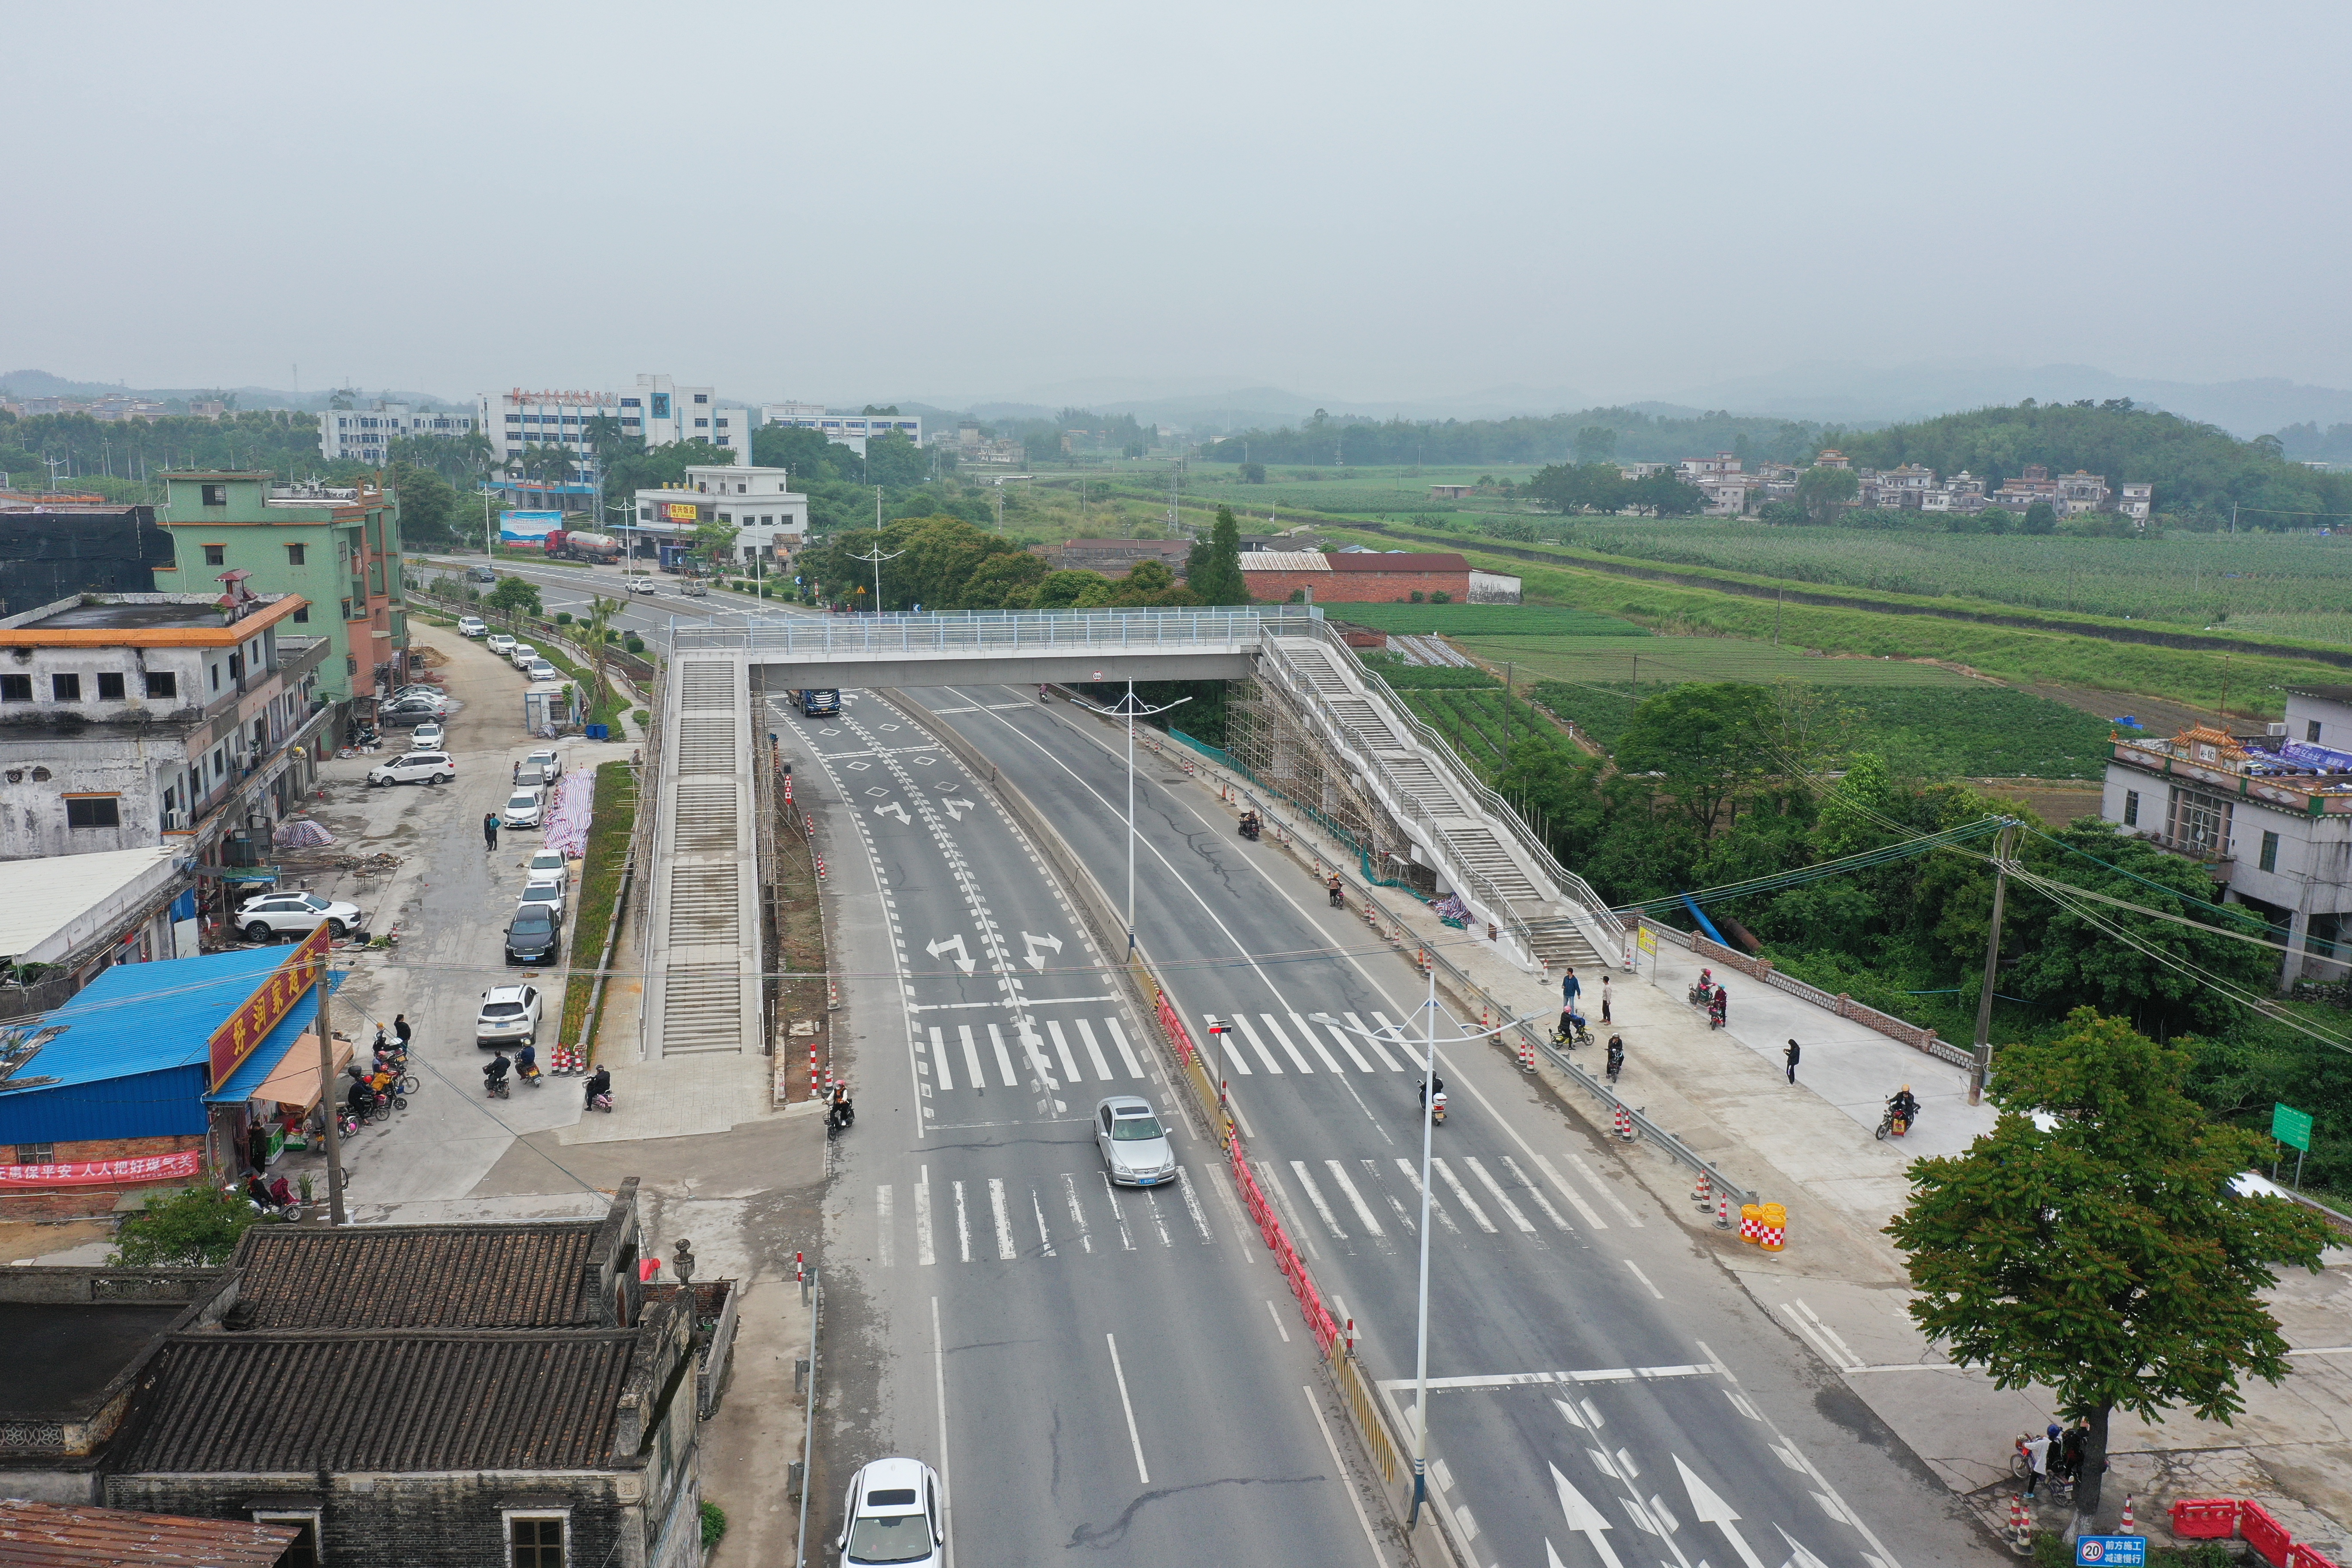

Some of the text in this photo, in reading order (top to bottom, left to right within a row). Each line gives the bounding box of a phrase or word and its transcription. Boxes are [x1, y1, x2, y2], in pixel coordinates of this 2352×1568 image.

[233, 948, 314, 1056] 好润家超市
[81, 1155, 193, 1177] 人人把好煤气关
[2085, 1545, 2099, 1556] 20
[2105, 1540, 2141, 1550] 前方施工
[2104, 1553, 2141, 1564] 减速慢行
